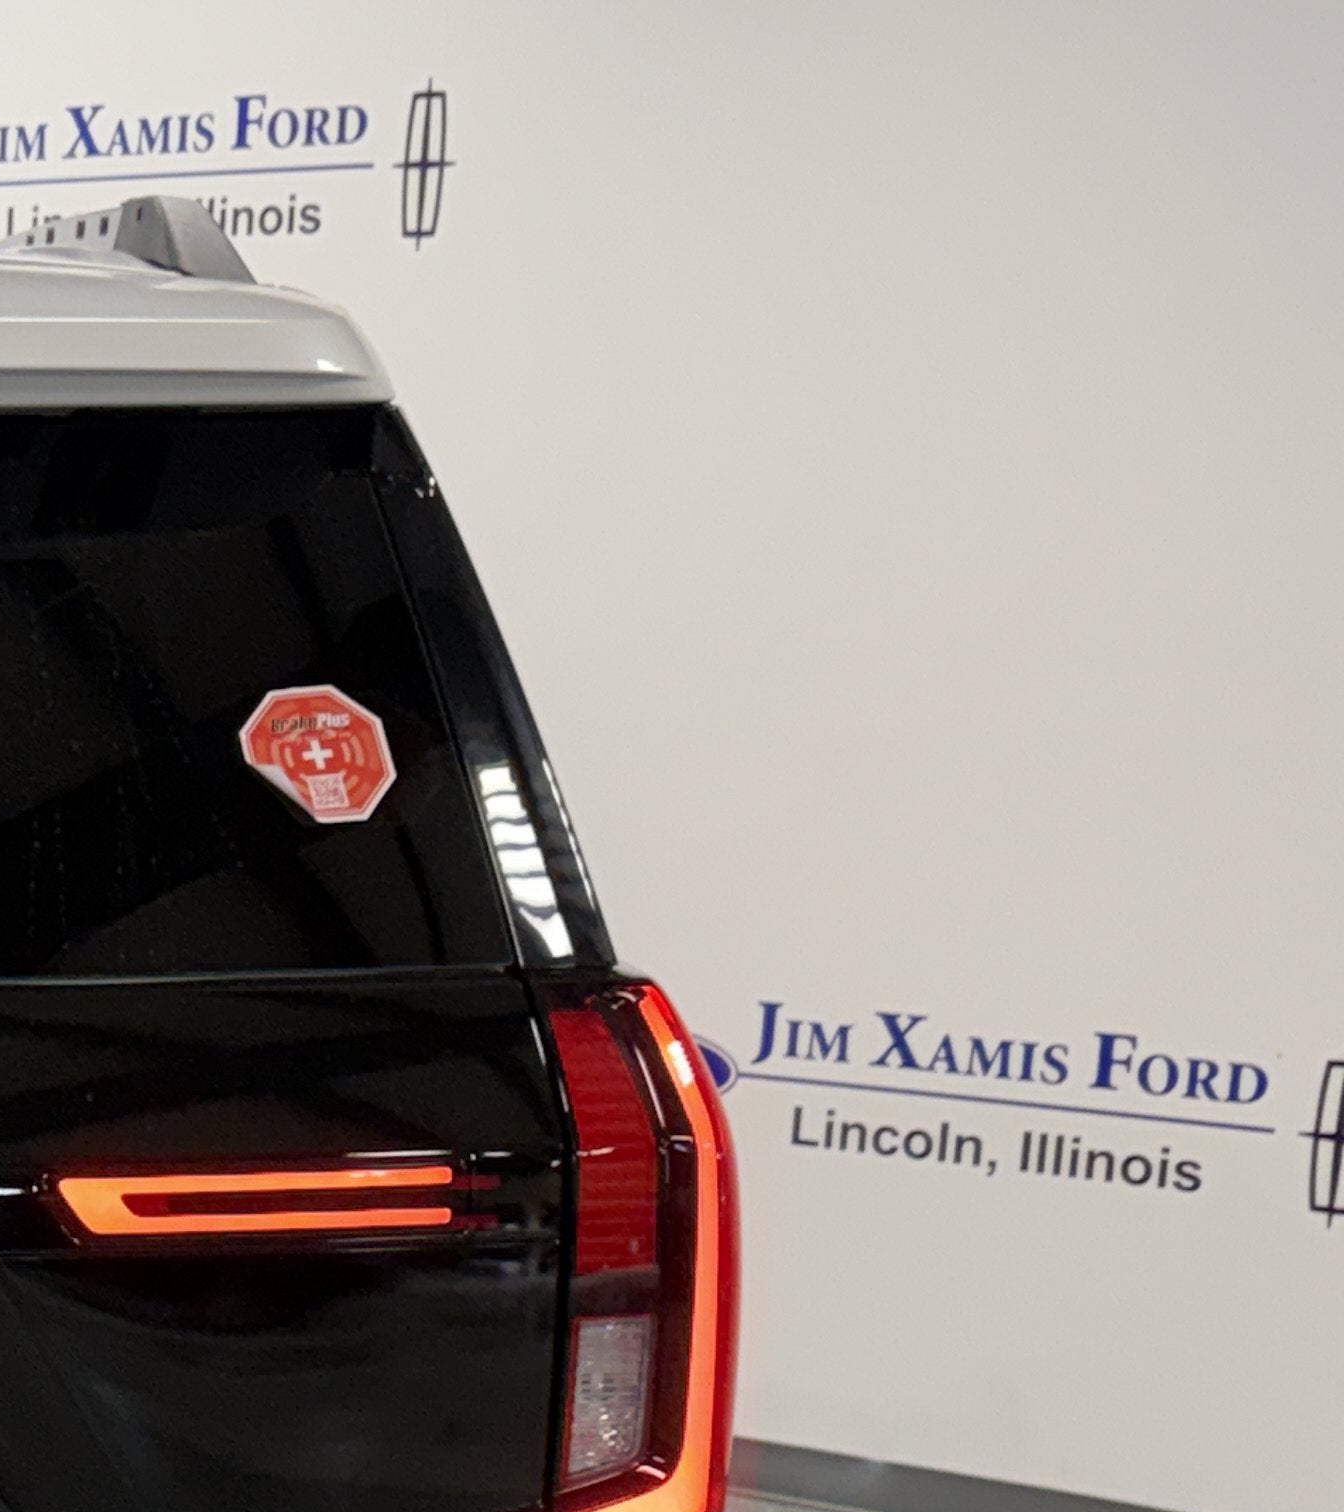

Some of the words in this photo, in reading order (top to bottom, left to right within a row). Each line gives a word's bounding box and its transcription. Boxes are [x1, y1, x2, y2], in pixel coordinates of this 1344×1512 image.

[64, 106, 214, 160] XAMIS
[231, 95, 367, 150] FORD
[751, 1001, 853, 1065] JIM
[869, 1012, 1070, 1086] XAMIS
[1089, 1032, 1269, 1104] FORD
[791, 1106, 998, 1176] Lincoln,
[1019, 1131, 1203, 1194] Illinois
